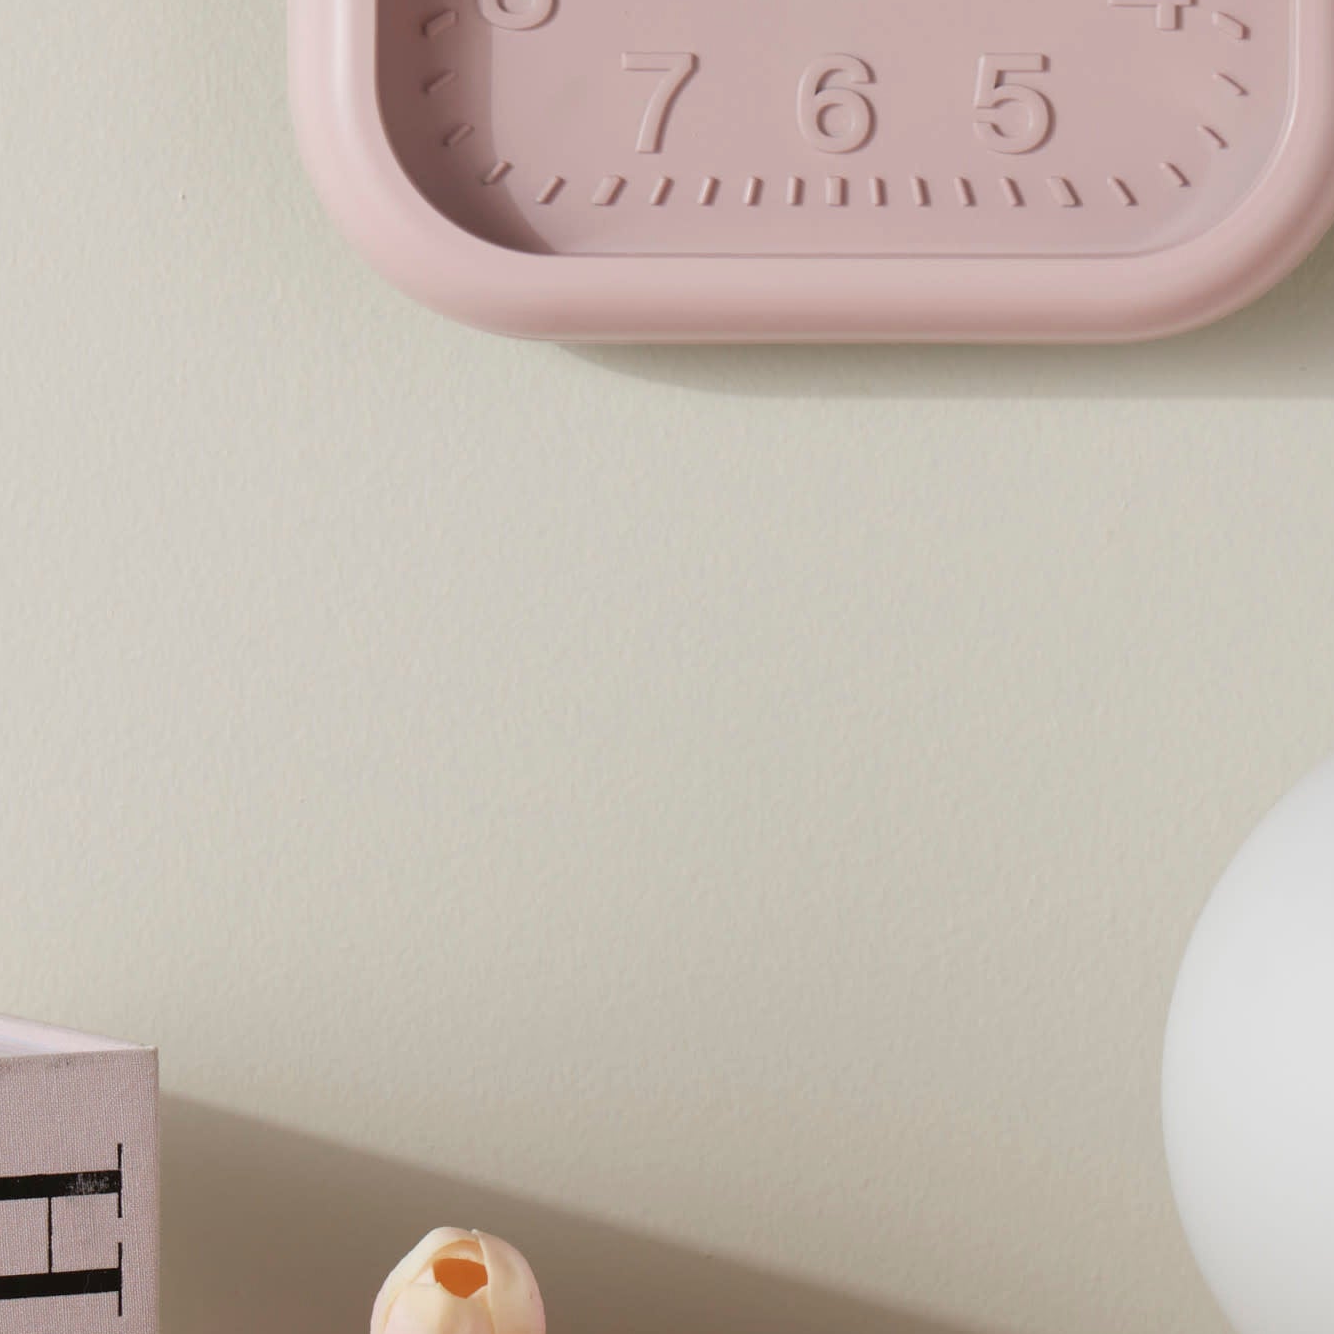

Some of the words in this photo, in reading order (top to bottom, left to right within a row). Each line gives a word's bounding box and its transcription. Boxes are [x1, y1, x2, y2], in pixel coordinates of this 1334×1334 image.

[622, 52, 700, 154] 7
[796, 53, 877, 154] 6
[973, 53, 1056, 155] 5
